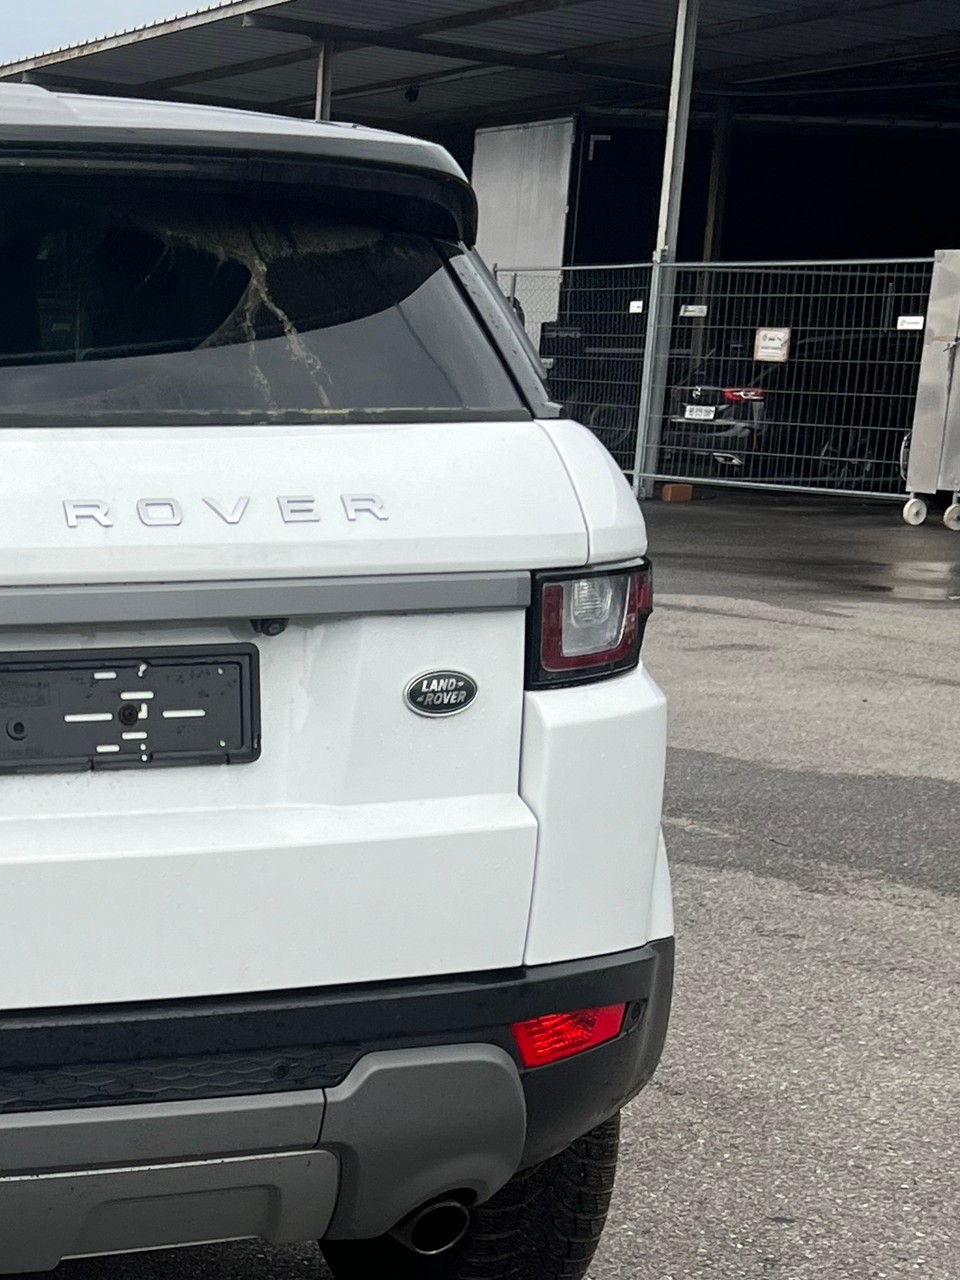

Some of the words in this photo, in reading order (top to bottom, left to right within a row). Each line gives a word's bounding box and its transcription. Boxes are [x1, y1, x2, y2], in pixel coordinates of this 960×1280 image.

[62, 494, 389, 528] ROVER
[421, 678, 457, 692] LAND
[423, 690, 467, 705] ROVER
